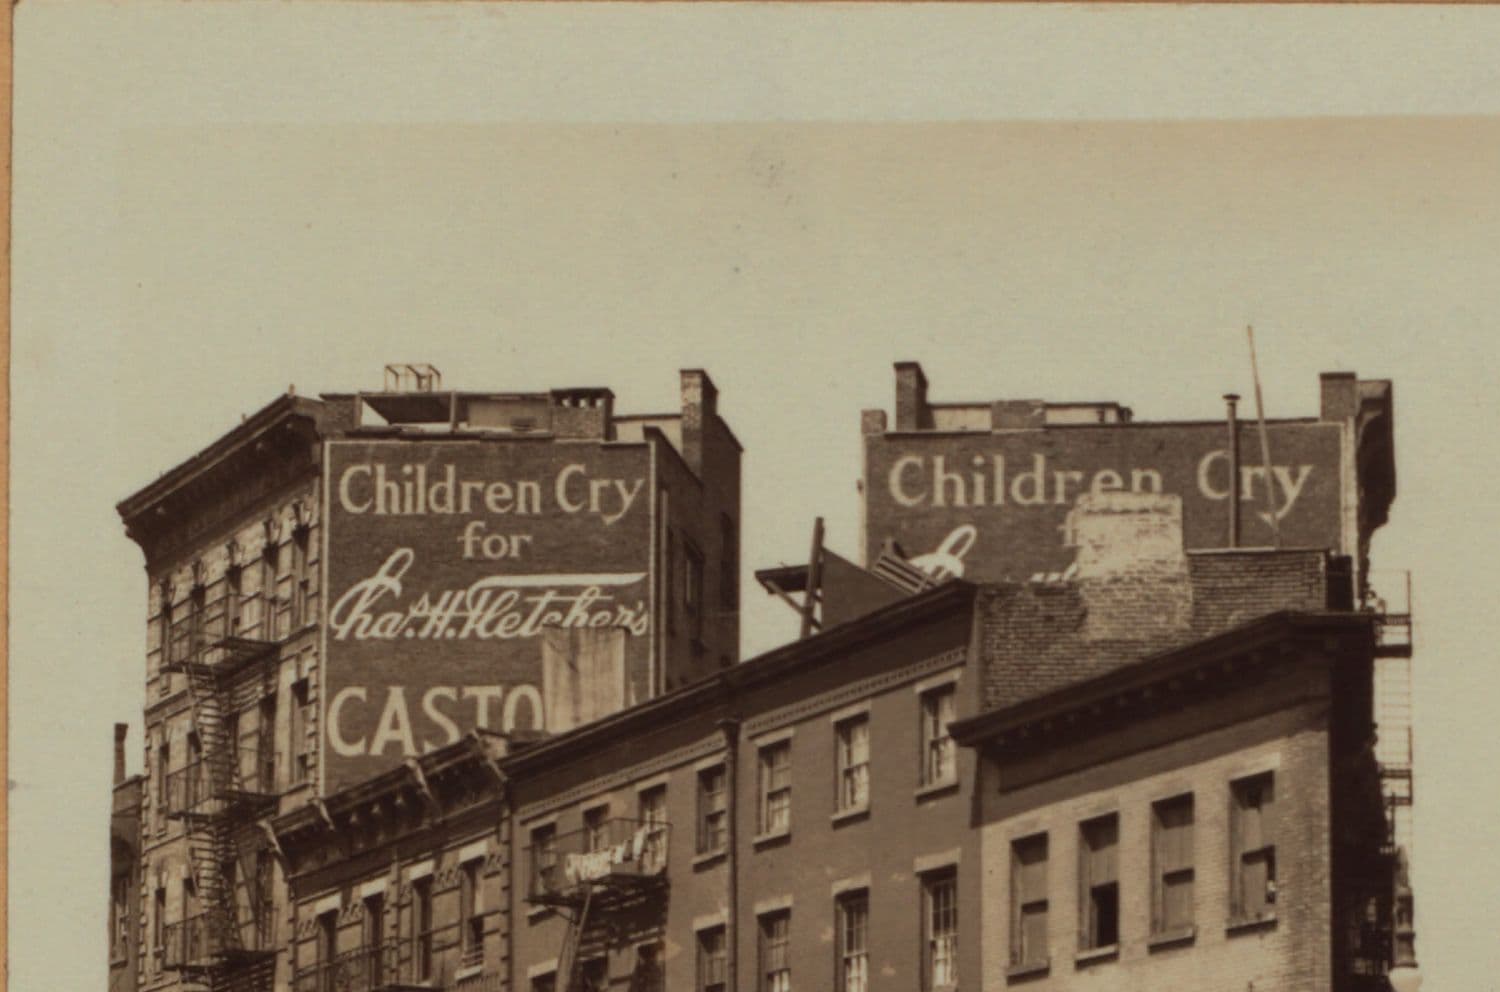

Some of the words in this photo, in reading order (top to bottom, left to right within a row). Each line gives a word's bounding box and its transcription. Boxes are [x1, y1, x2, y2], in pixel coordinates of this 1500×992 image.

[339, 463, 542, 515] Children
[555, 464, 645, 525] Cry
[888, 453, 1165, 506] Children
[1197, 449, 1313, 527] Cry
[457, 520, 533, 559] for
[326, 684, 545, 757] CASTO
